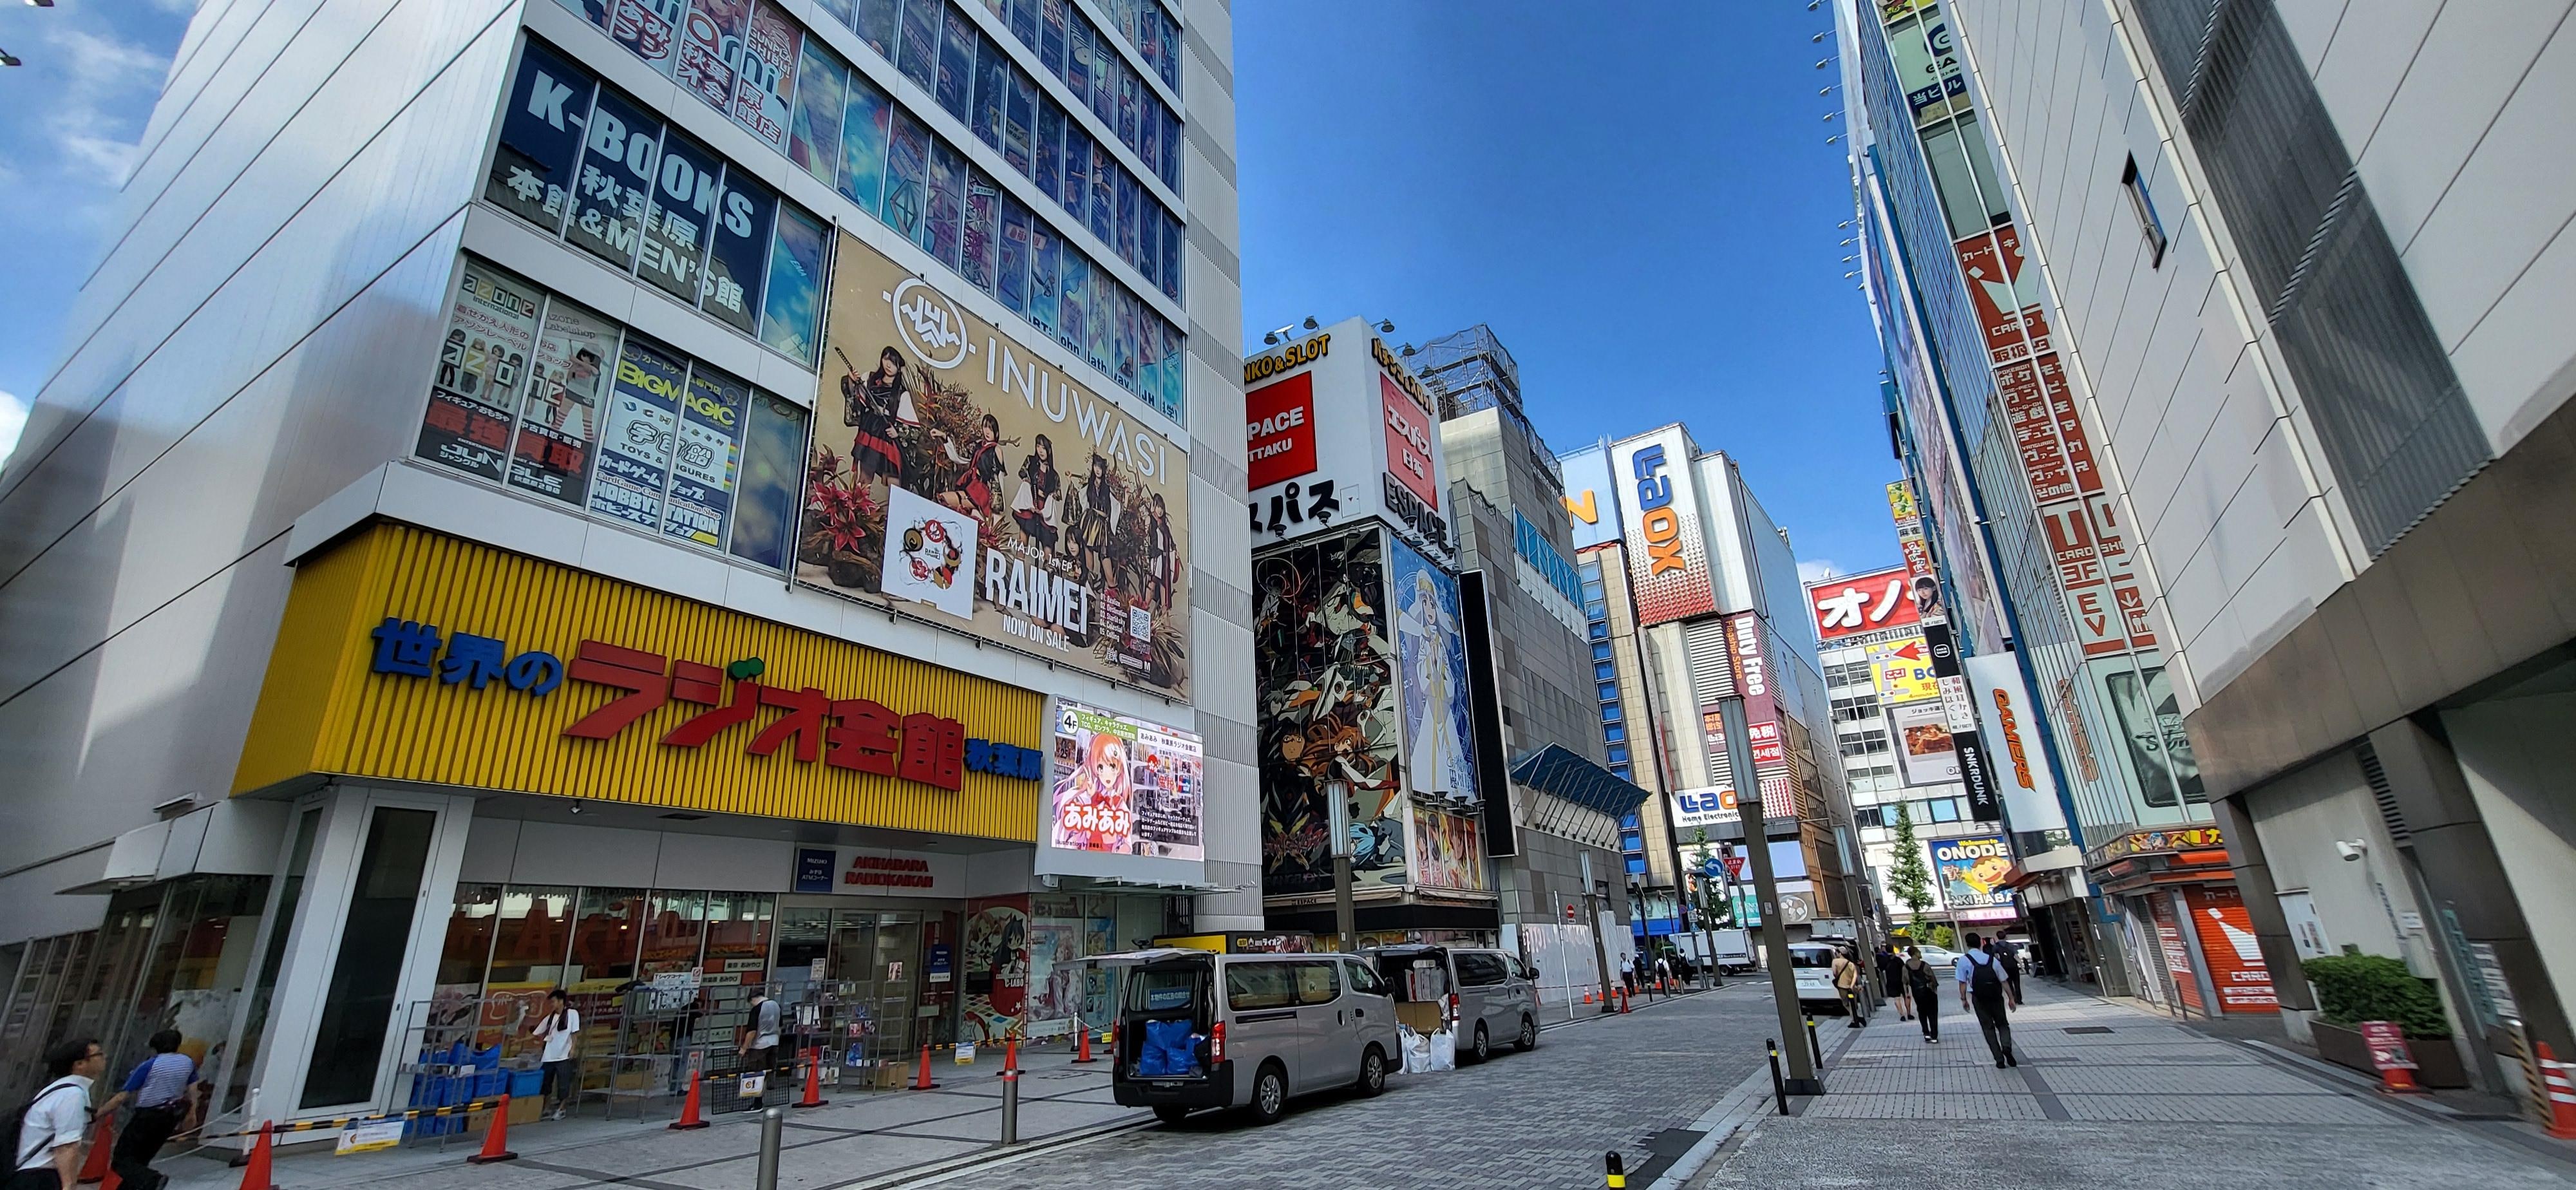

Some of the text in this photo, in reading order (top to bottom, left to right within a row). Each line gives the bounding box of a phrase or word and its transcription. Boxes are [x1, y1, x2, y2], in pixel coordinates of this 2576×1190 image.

[1912, 79, 1962, 106] 当ビル
[527, 69, 755, 238] K-BOOKS
[580, 164, 700, 252] 秋葉原
[1991, 317, 2034, 336] CARD
[1998, 363, 2030, 375] POKEMON
[616, 359, 736, 426] BIGMAGIC
[986, 335, 1167, 486] INUWASI
[1387, 404, 1432, 462] エスパス
[620, 441, 716, 484] TOYS & IGURES
[701, 505, 721, 520] Shop
[1899, 526, 1922, 538] 麻雀
[1007, 536, 1044, 560] MAJOR
[1061, 558, 1074, 572] EP
[2057, 546, 2093, 562] CARD
[985, 546, 1088, 635] RAIMEI
[1107, 595, 1121, 607] Realize
[1816, 578, 1913, 630] オノ
[2077, 591, 2107, 637] EV
[1003, 614, 1070, 653] NOW ON SALE
[1725, 619, 1743, 680] Flagship Store
[1735, 616, 1766, 697] Duty Free
[371, 616, 1044, 793] 世界の ラジオ会館 秋葉原
[1063, 712, 1078, 729] 4F
[1748, 724, 1776, 740] 免税
[1992, 687, 2037, 794] GAMERS
[1963, 746, 1989, 806] SNKRDUNK
[1064, 802, 1132, 836] あみあみ
[1681, 814, 1702, 823] Home
[853, 855, 930, 873] AKIHABARA
[1937, 842, 2008, 861] ONODE
[844, 871, 934, 888] RADIOKAIKAN
